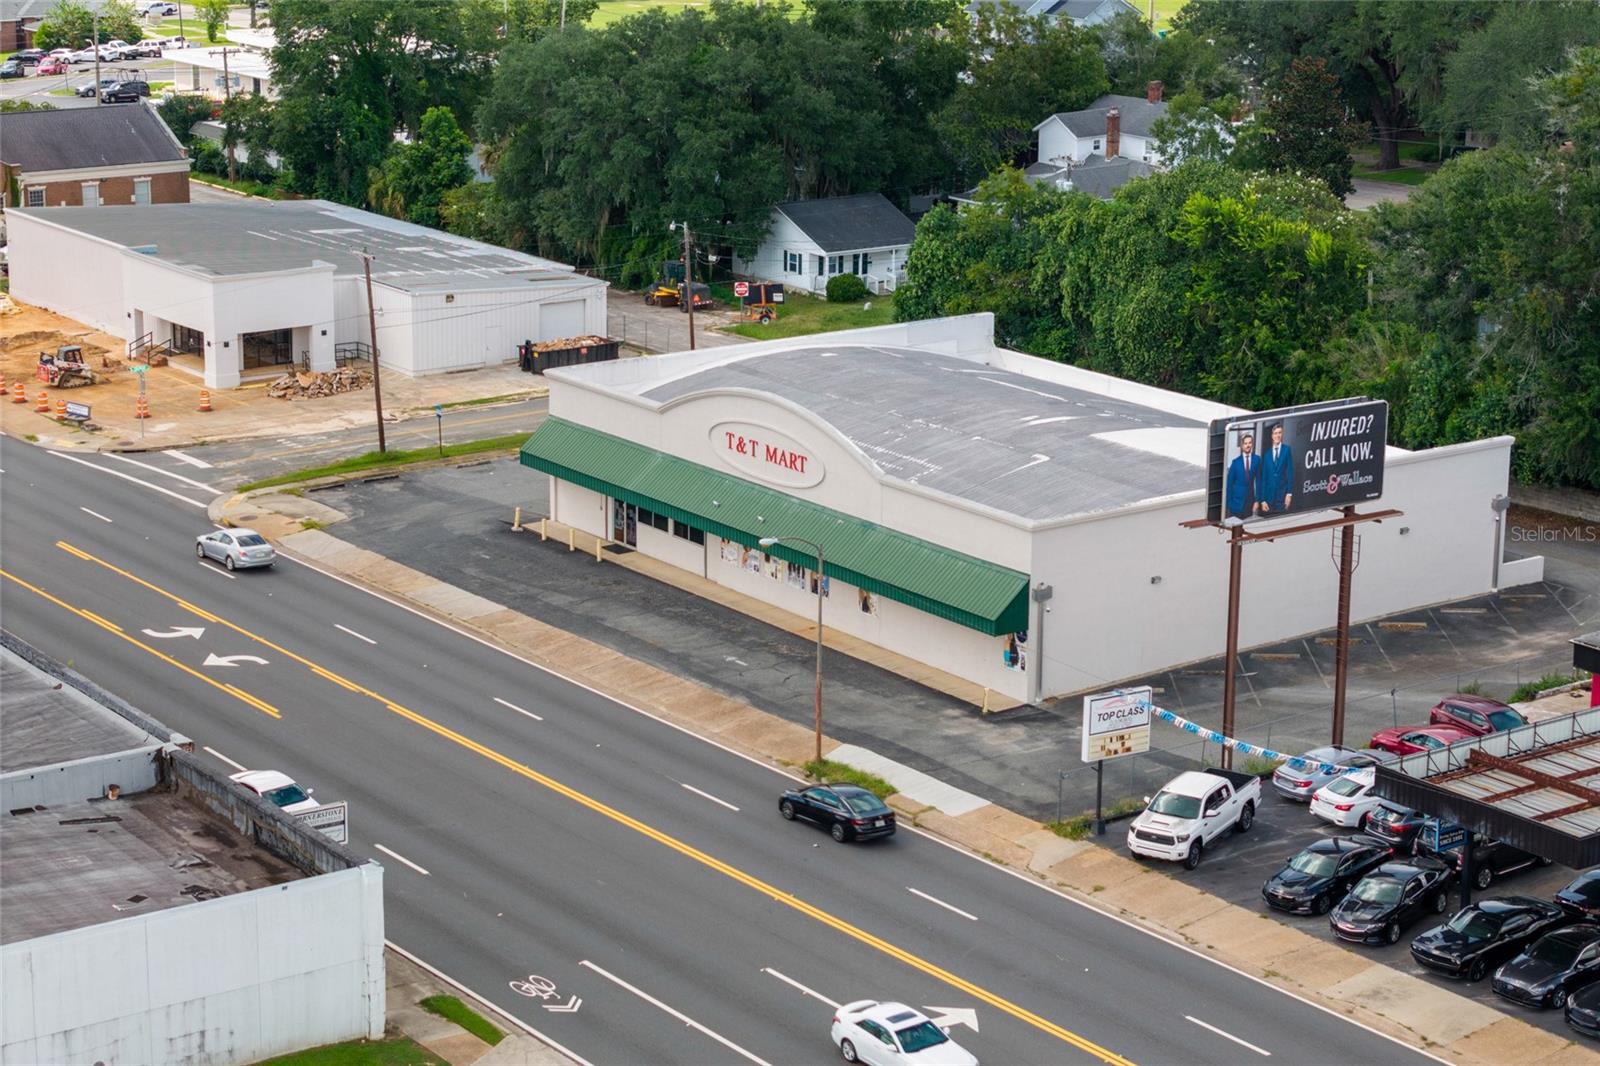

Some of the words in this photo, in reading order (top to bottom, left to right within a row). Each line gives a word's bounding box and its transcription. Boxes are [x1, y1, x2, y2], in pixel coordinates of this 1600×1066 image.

[1310, 414, 1374, 442] INJURED?
[725, 431, 759, 458] T&T
[765, 444, 808, 473] MART
[1305, 446, 1337, 469] CALL
[1341, 441, 1374, 462] NOW.
[1303, 480, 1328, 494] Scott
[1326, 473, 1340, 495] &
[1339, 470, 1373, 486] Wallace
[1097, 711, 1115, 722] TOP
[1116, 705, 1145, 719] CLASS
